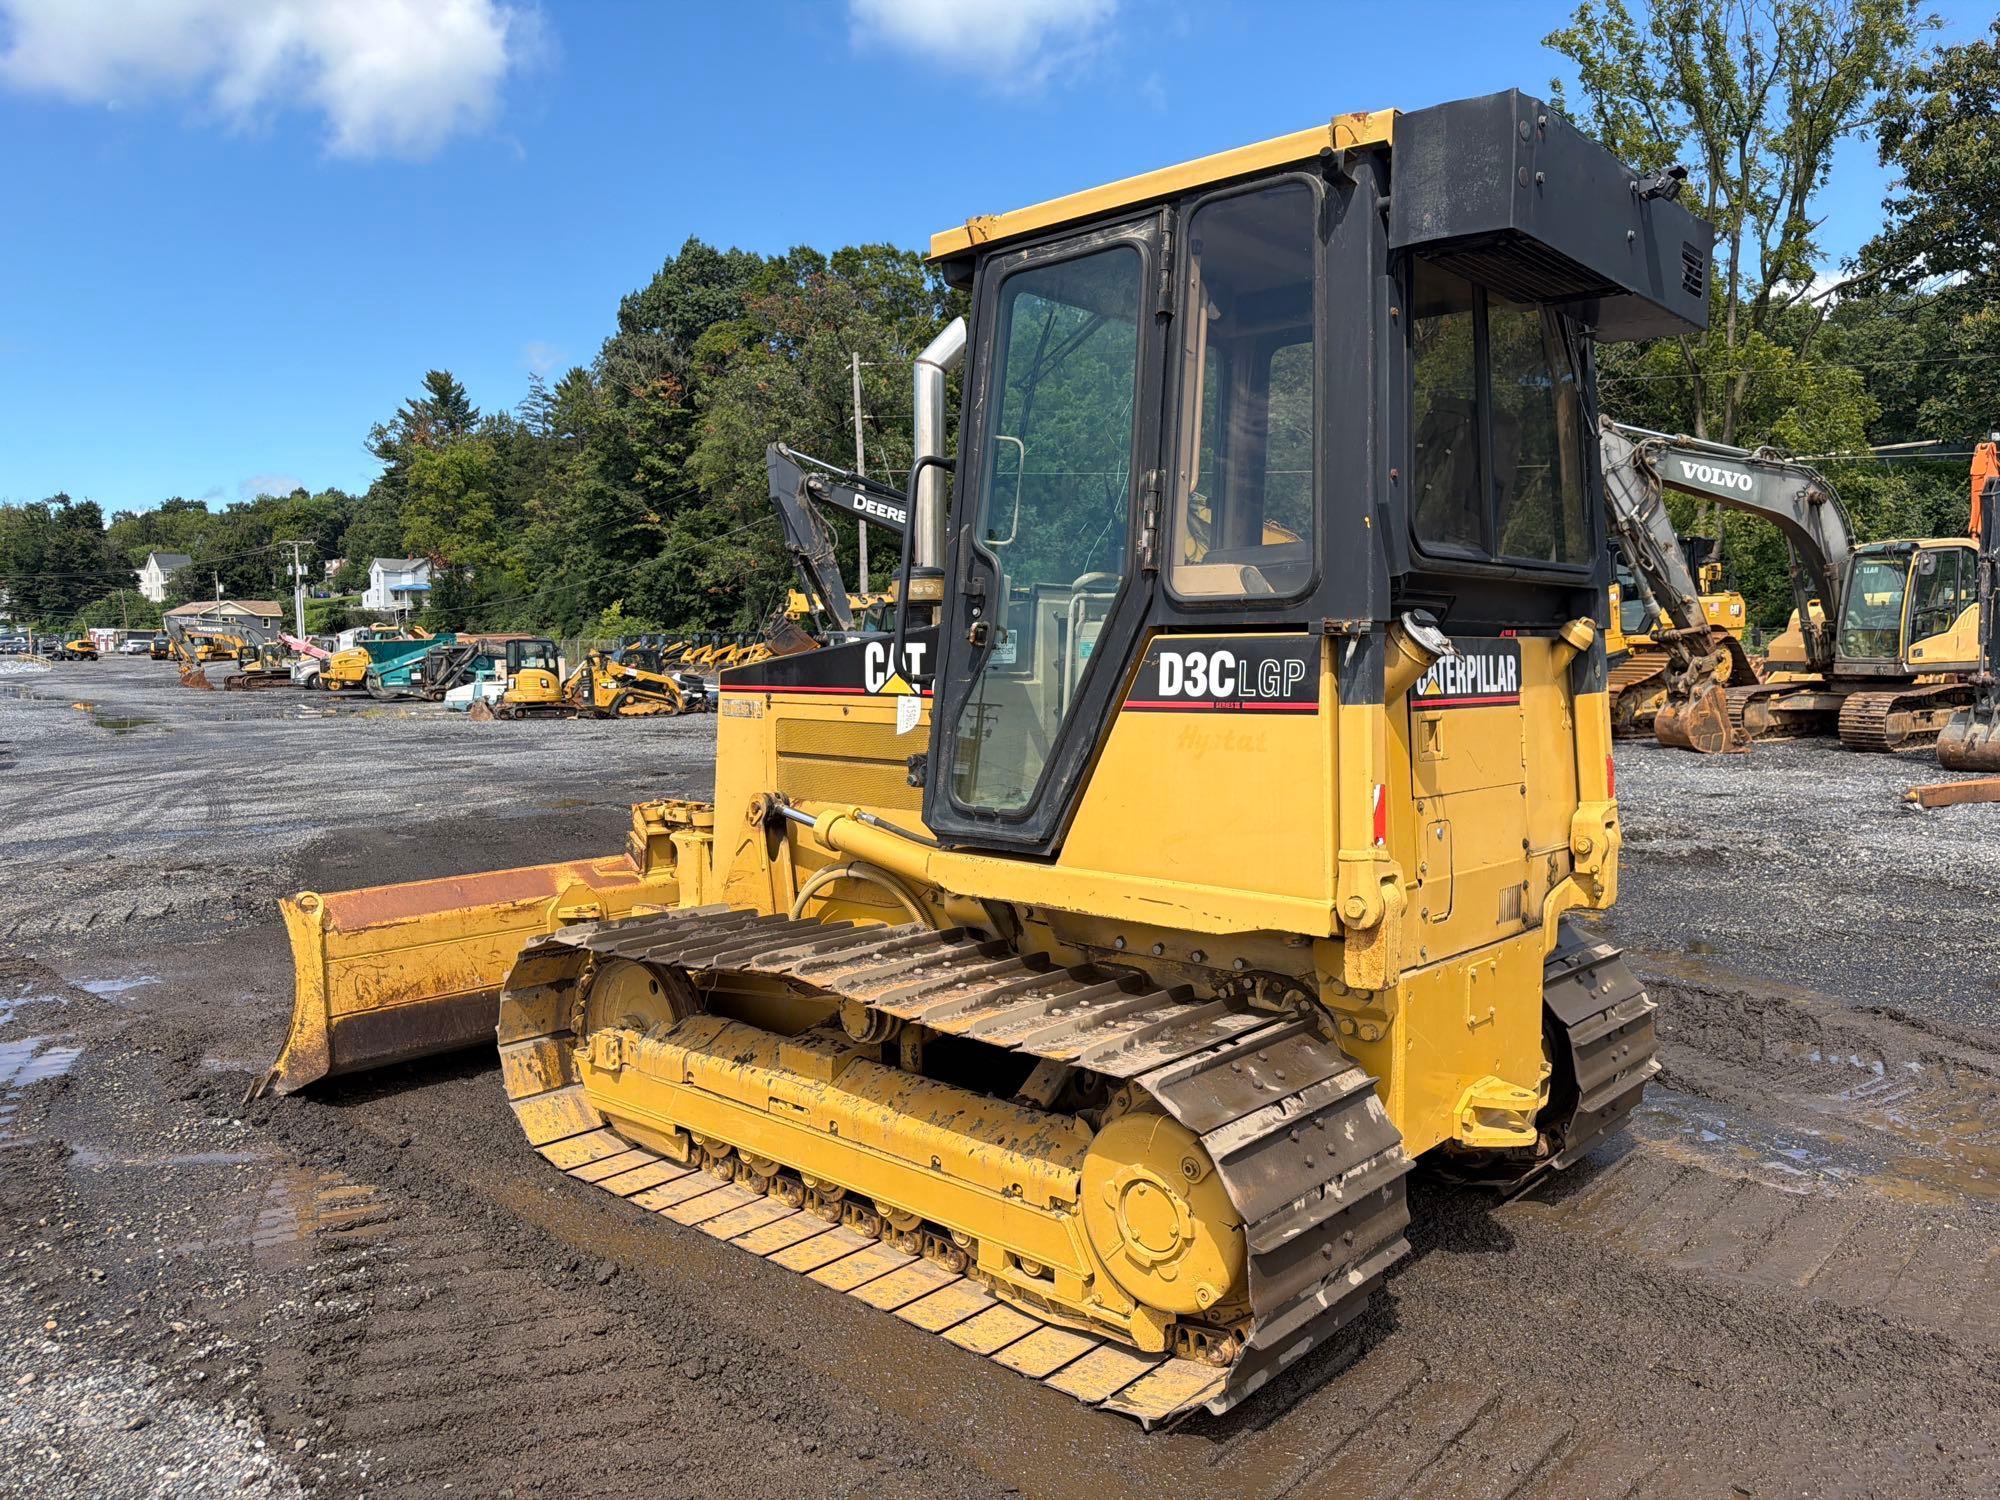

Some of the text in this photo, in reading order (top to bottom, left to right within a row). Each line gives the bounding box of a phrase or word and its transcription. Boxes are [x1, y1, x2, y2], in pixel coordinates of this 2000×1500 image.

[1680, 460, 1753, 491] VOLVO
[853, 493, 907, 524] DEERE
[1158, 650, 1306, 698] D3C LGP
